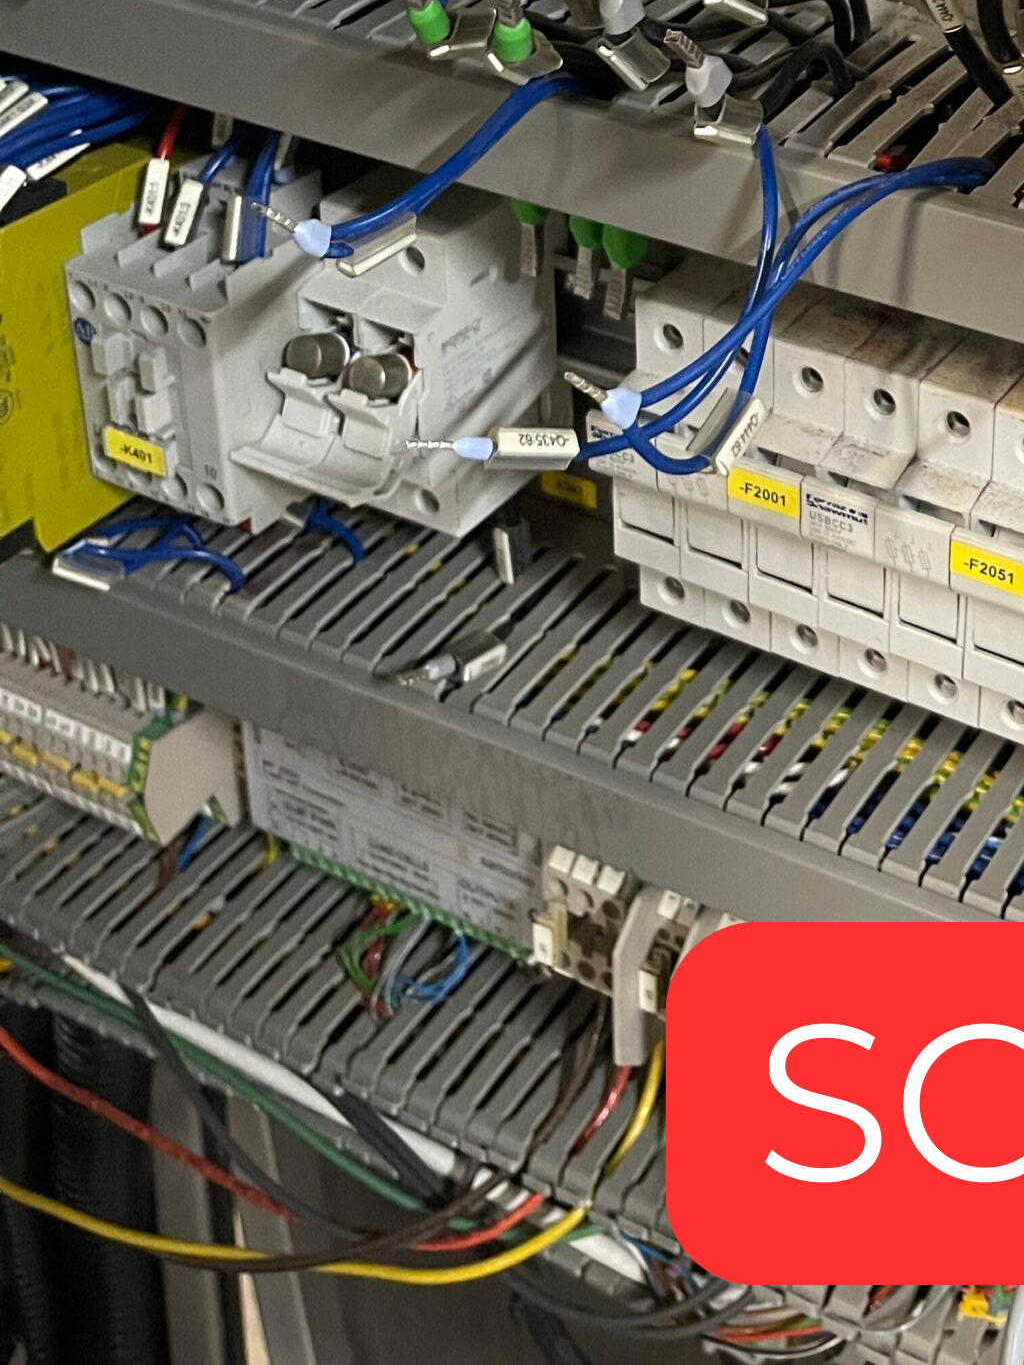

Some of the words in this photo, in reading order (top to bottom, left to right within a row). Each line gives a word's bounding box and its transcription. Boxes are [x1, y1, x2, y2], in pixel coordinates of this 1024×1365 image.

[519, 433, 570, 448] -Q435:62
[118, 443, 154, 465] -K401
[203, 464, 218, 480] 10
[739, 482, 788, 507] -F2001
[808, 510, 854, 533] USBCC3
[963, 557, 1016, 585] -F2051
